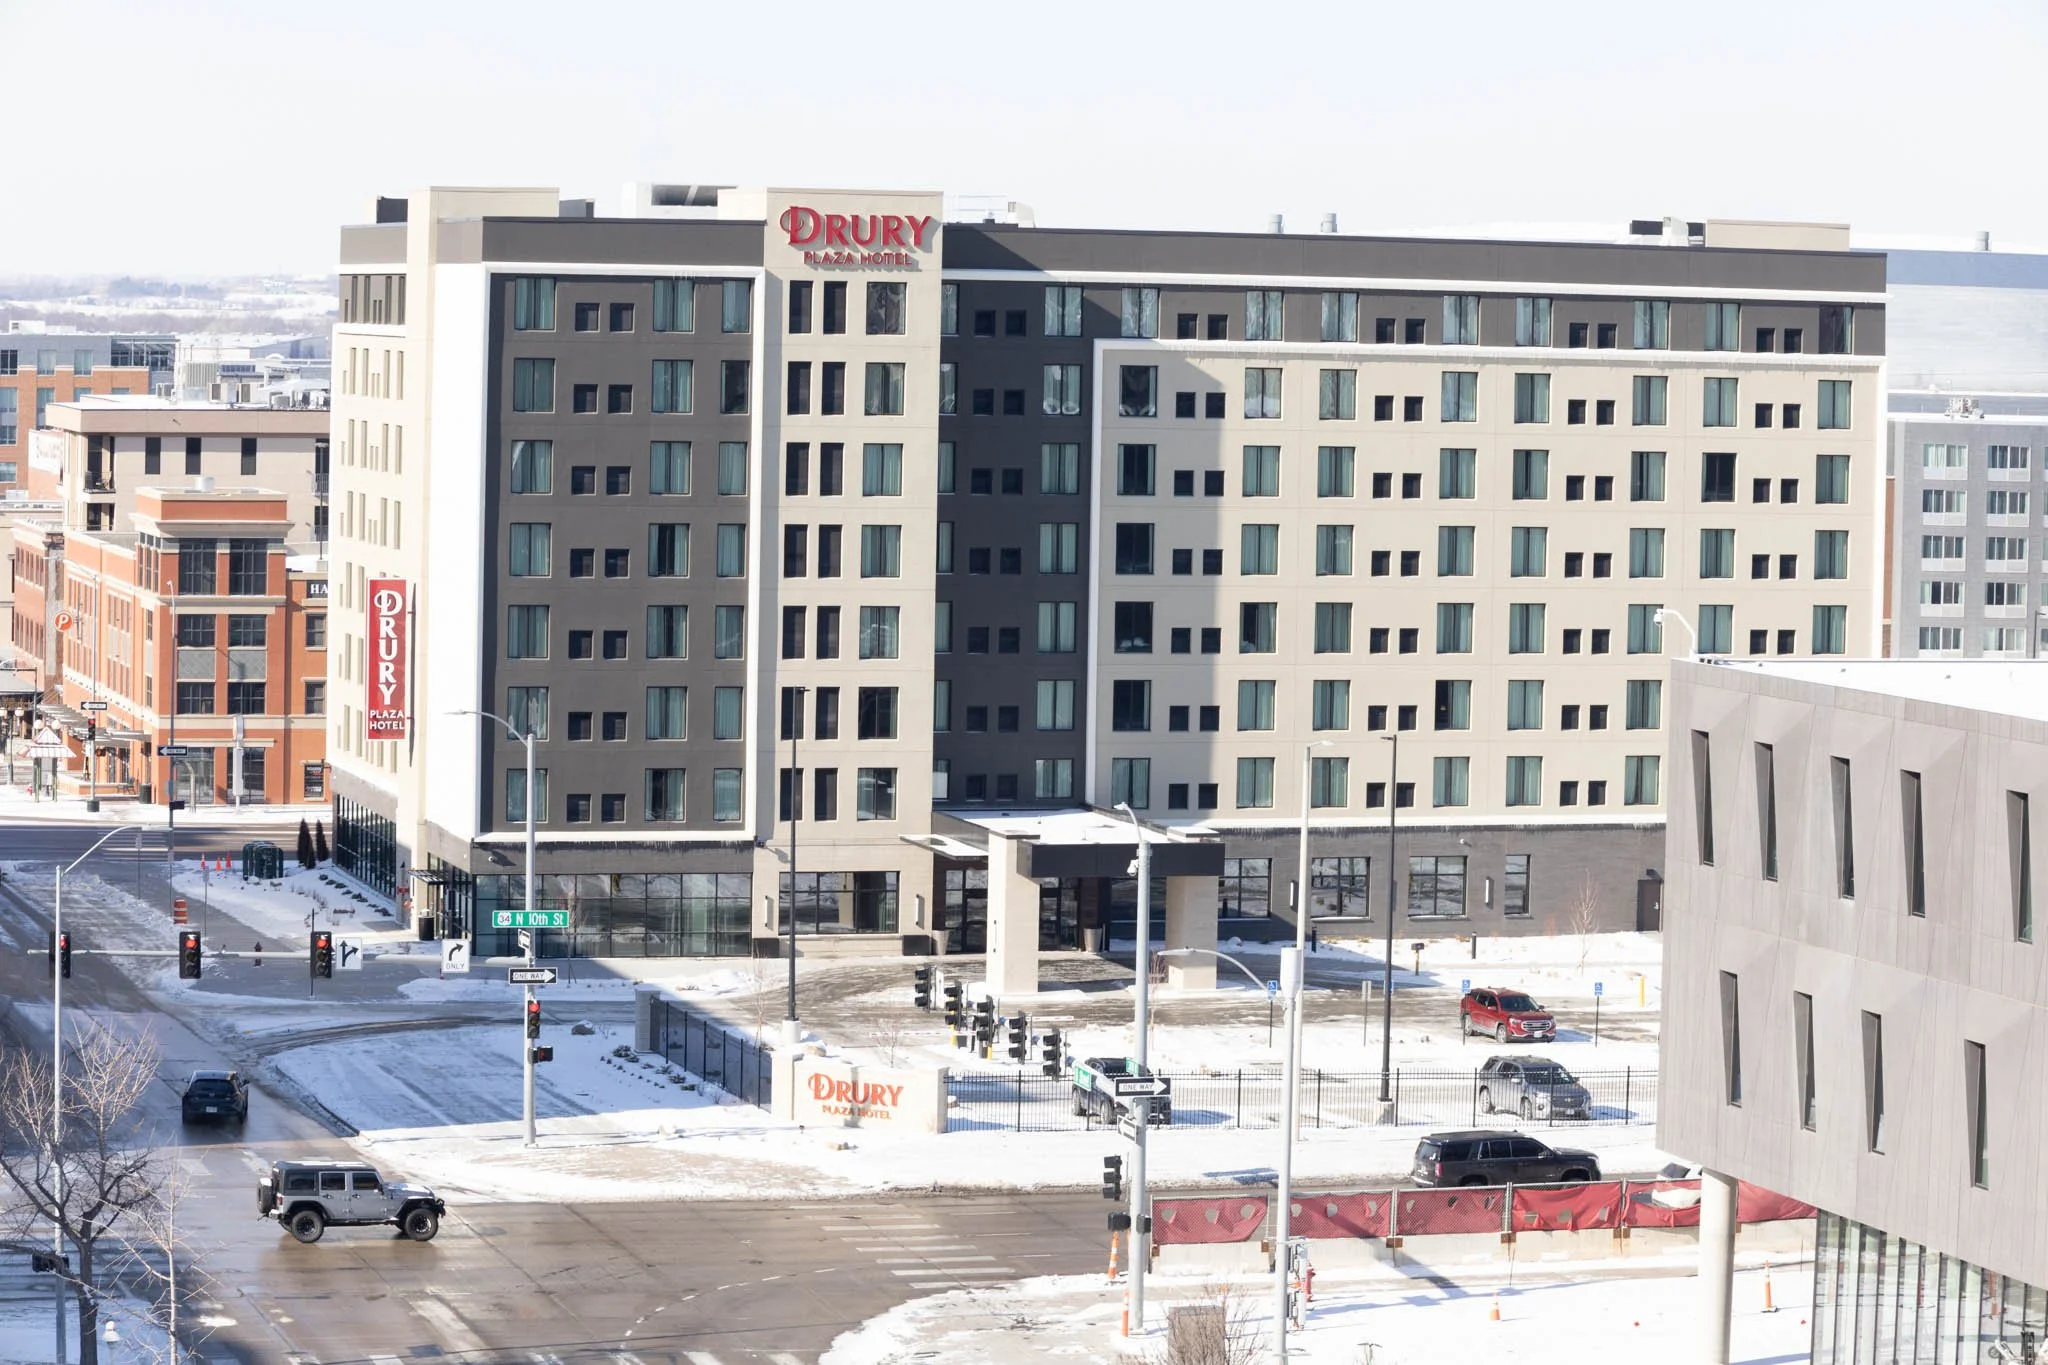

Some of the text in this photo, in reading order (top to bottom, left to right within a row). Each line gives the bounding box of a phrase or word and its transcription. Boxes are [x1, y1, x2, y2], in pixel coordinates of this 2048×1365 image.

[779, 206, 932, 247] DRURY
[803, 252, 912, 265] PLAZA HOTEL
[374, 590, 403, 705] DRURY
[370, 709, 404, 719] PLAZA
[370, 720, 404, 730] HOTEL
[516, 912, 524, 925] N
[528, 912, 548, 926] 10th
[553, 912, 564, 926] St
[808, 1073, 904, 1107] DRURY
[822, 1105, 892, 1120] PLAZA HOTEL
